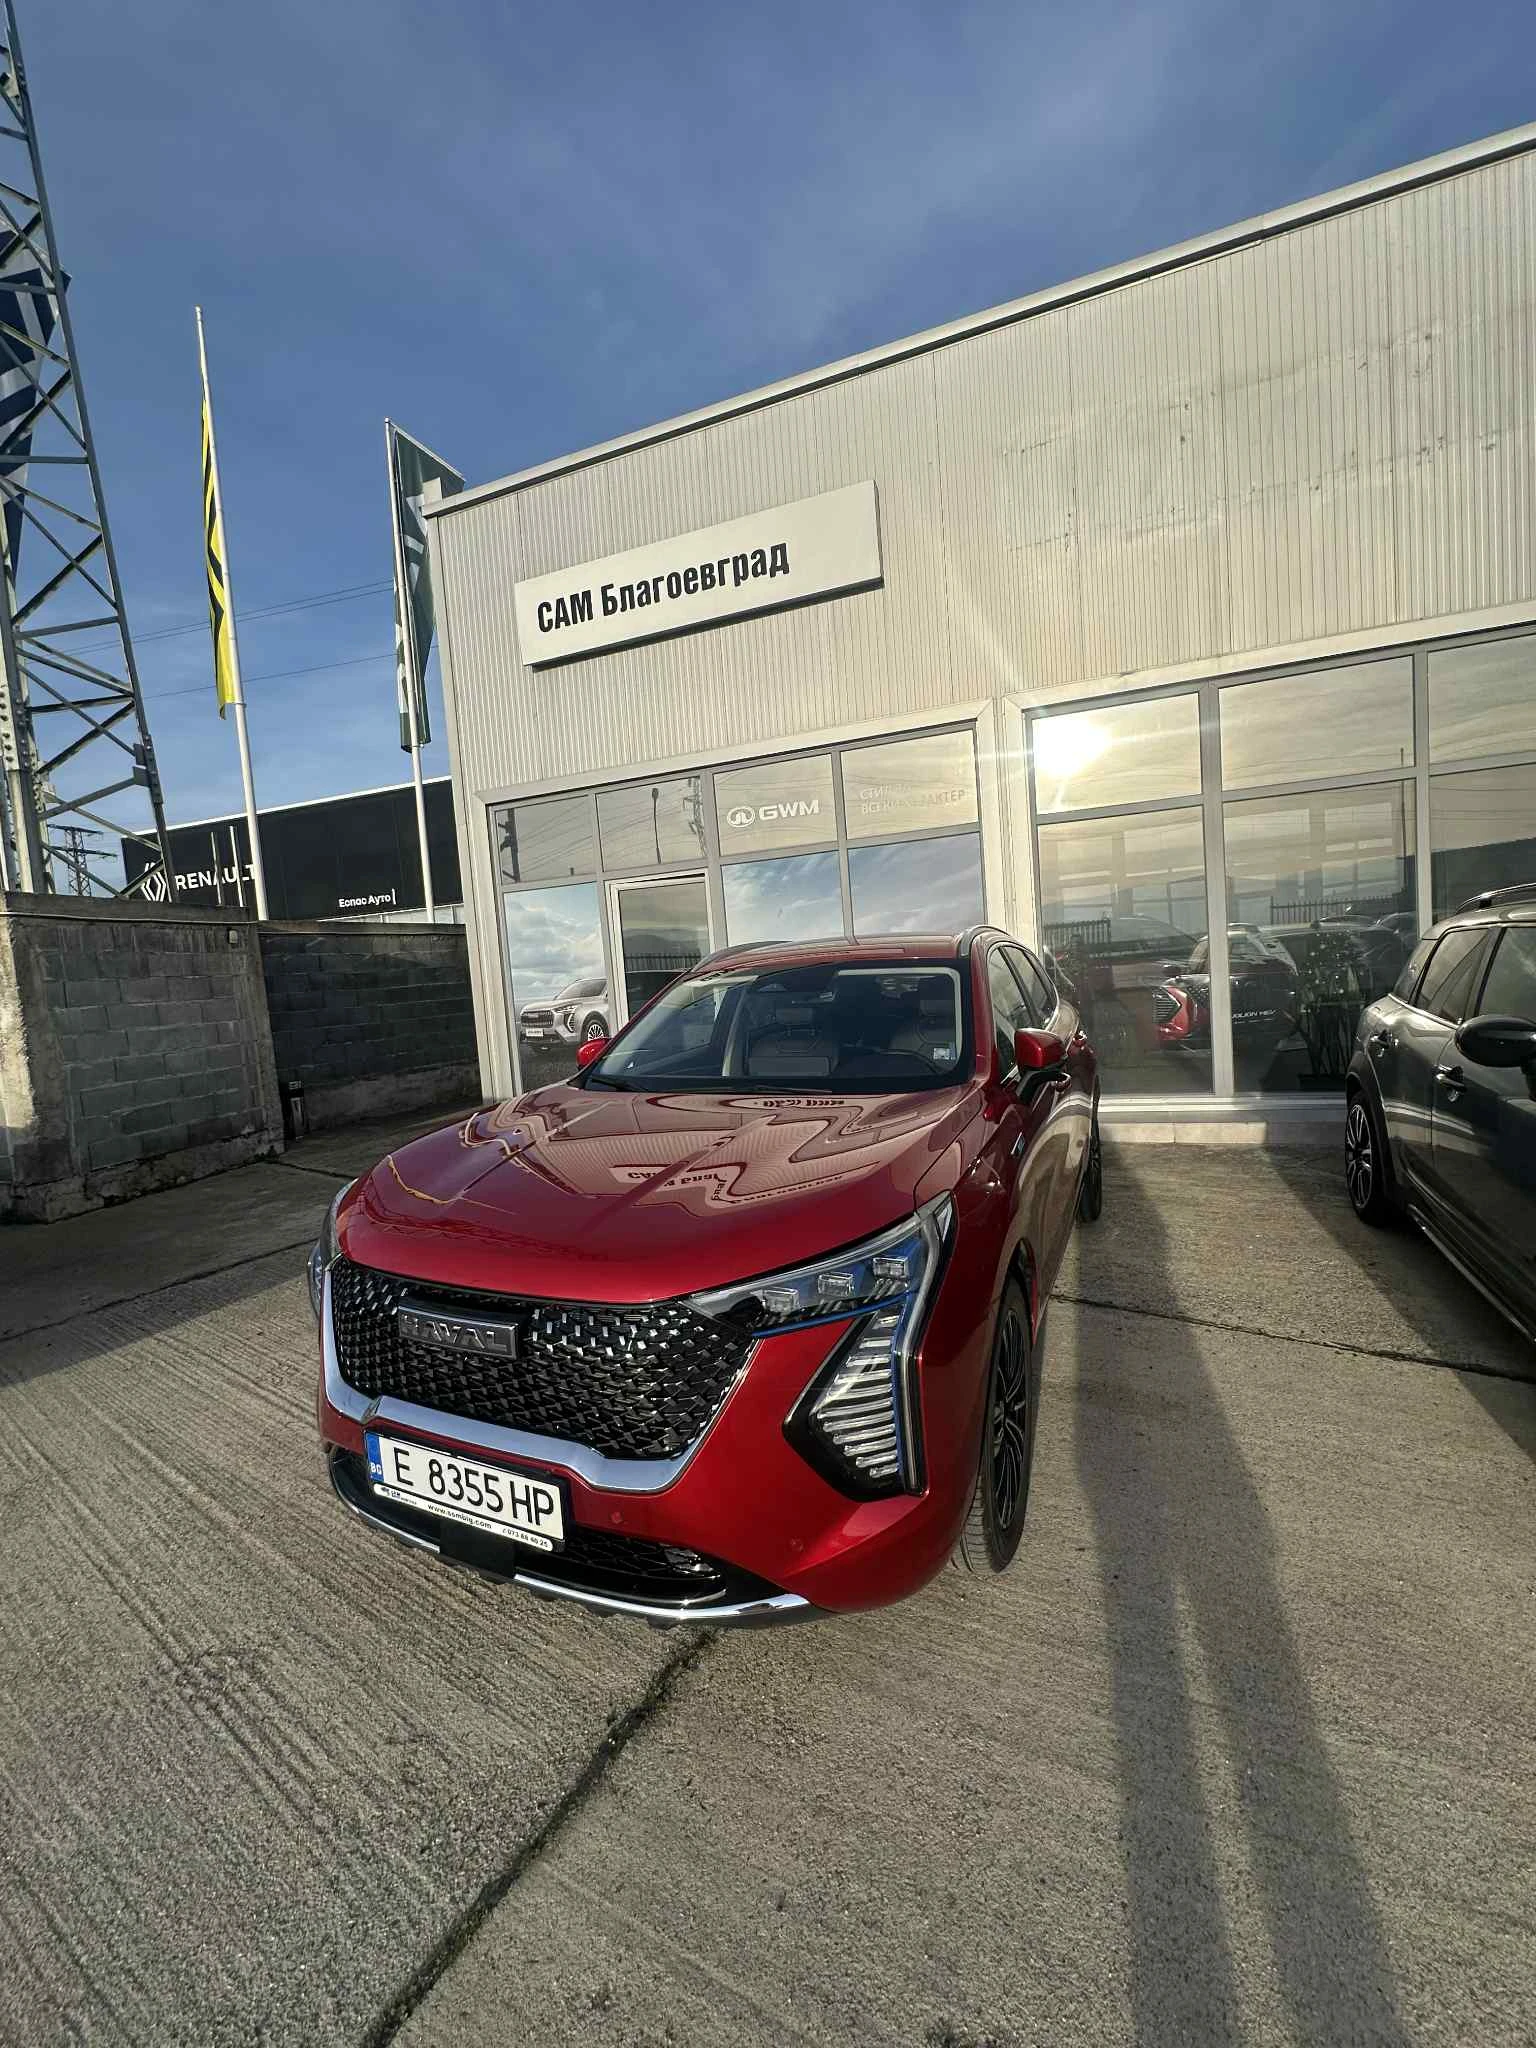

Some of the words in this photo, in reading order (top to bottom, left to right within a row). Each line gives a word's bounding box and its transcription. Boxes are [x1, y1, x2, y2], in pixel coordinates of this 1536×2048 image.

[537, 589, 594, 633] САМ
[601, 542, 790, 617] Благоевград
[758, 799, 821, 821] GWM
[370, 1461, 382, 1476] BG
[393, 1446, 414, 1487] E
[428, 1458, 504, 1514] 8355
[509, 1480, 554, 1526] HP
